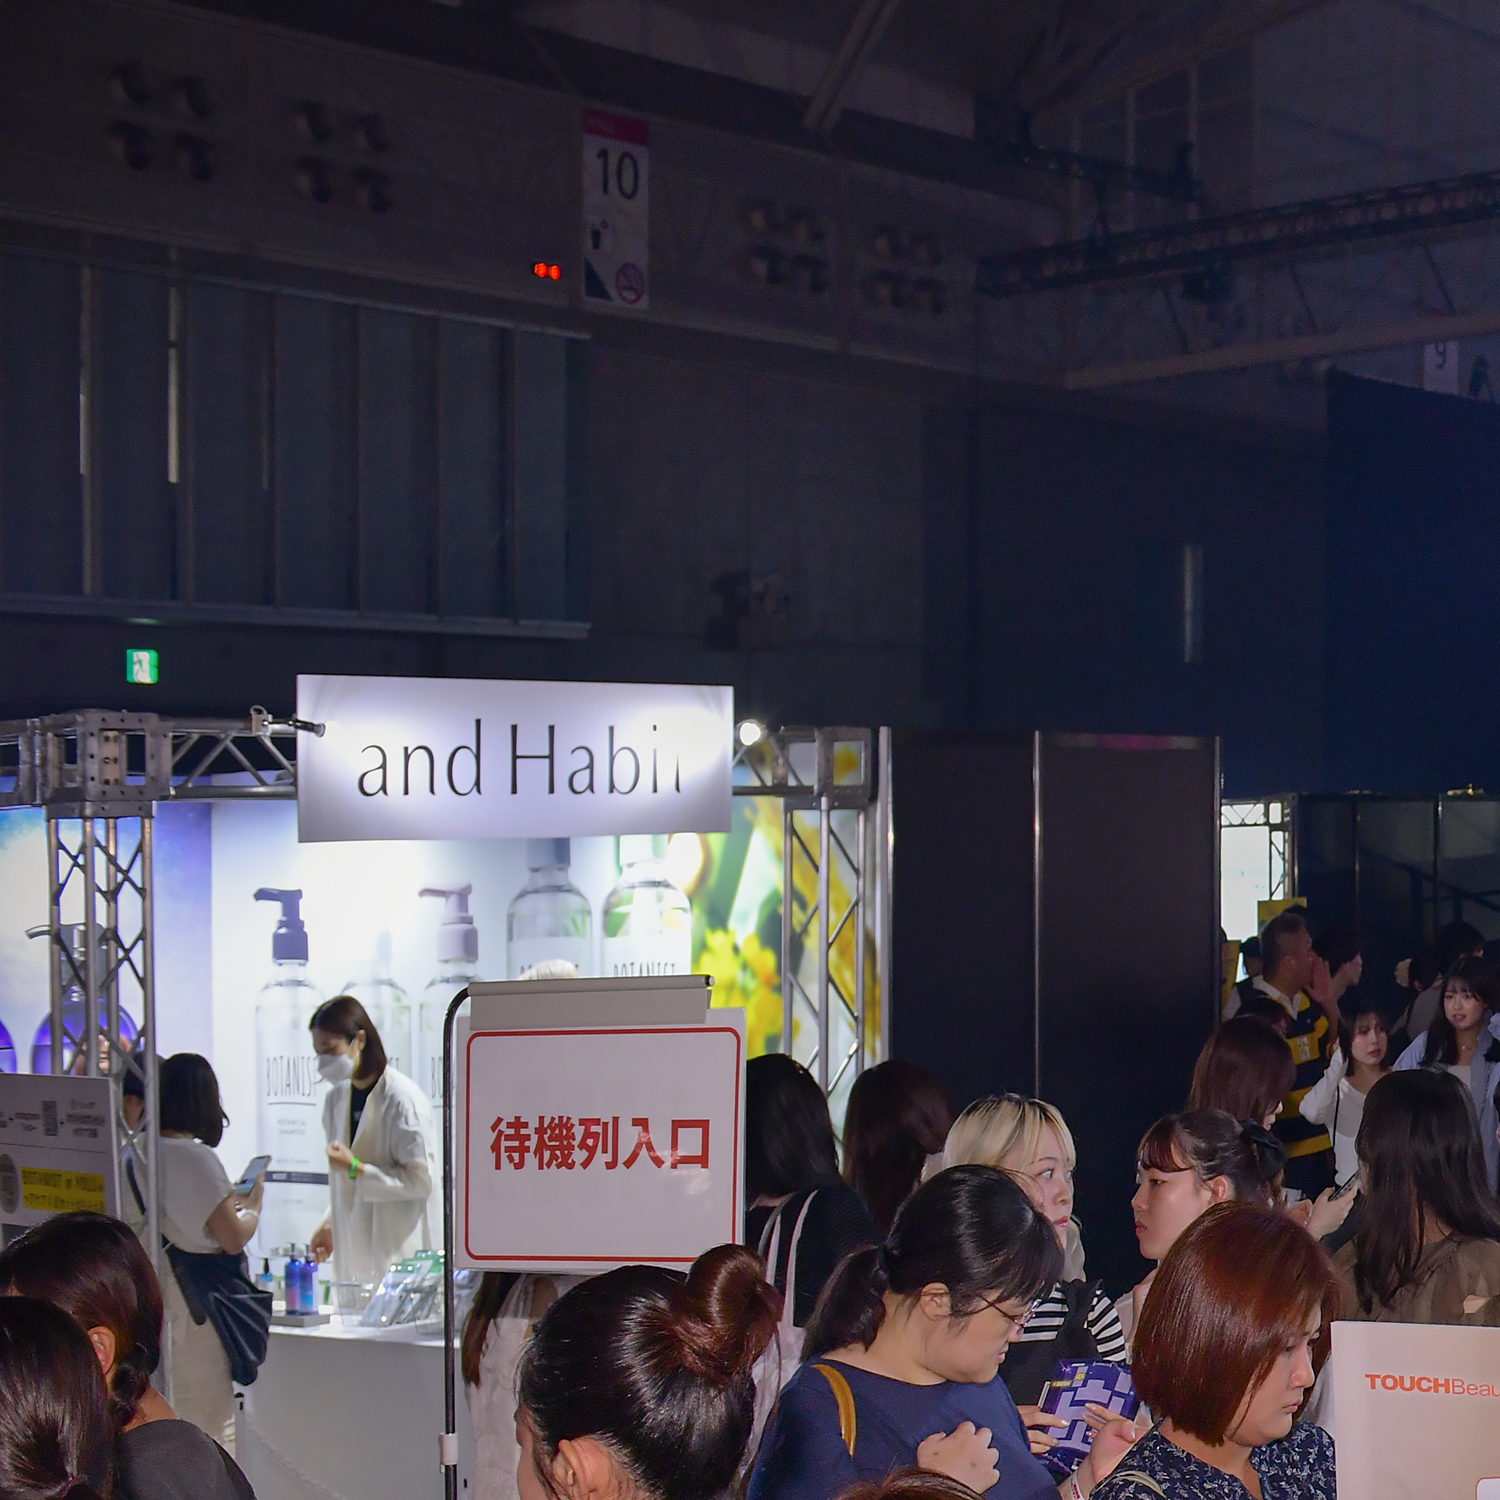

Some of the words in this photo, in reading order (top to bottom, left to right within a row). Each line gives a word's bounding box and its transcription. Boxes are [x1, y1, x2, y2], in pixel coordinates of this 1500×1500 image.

[596, 148, 640, 200] 10
[357, 718, 483, 797] and
[490, 1115, 711, 1170] 待機列入口
